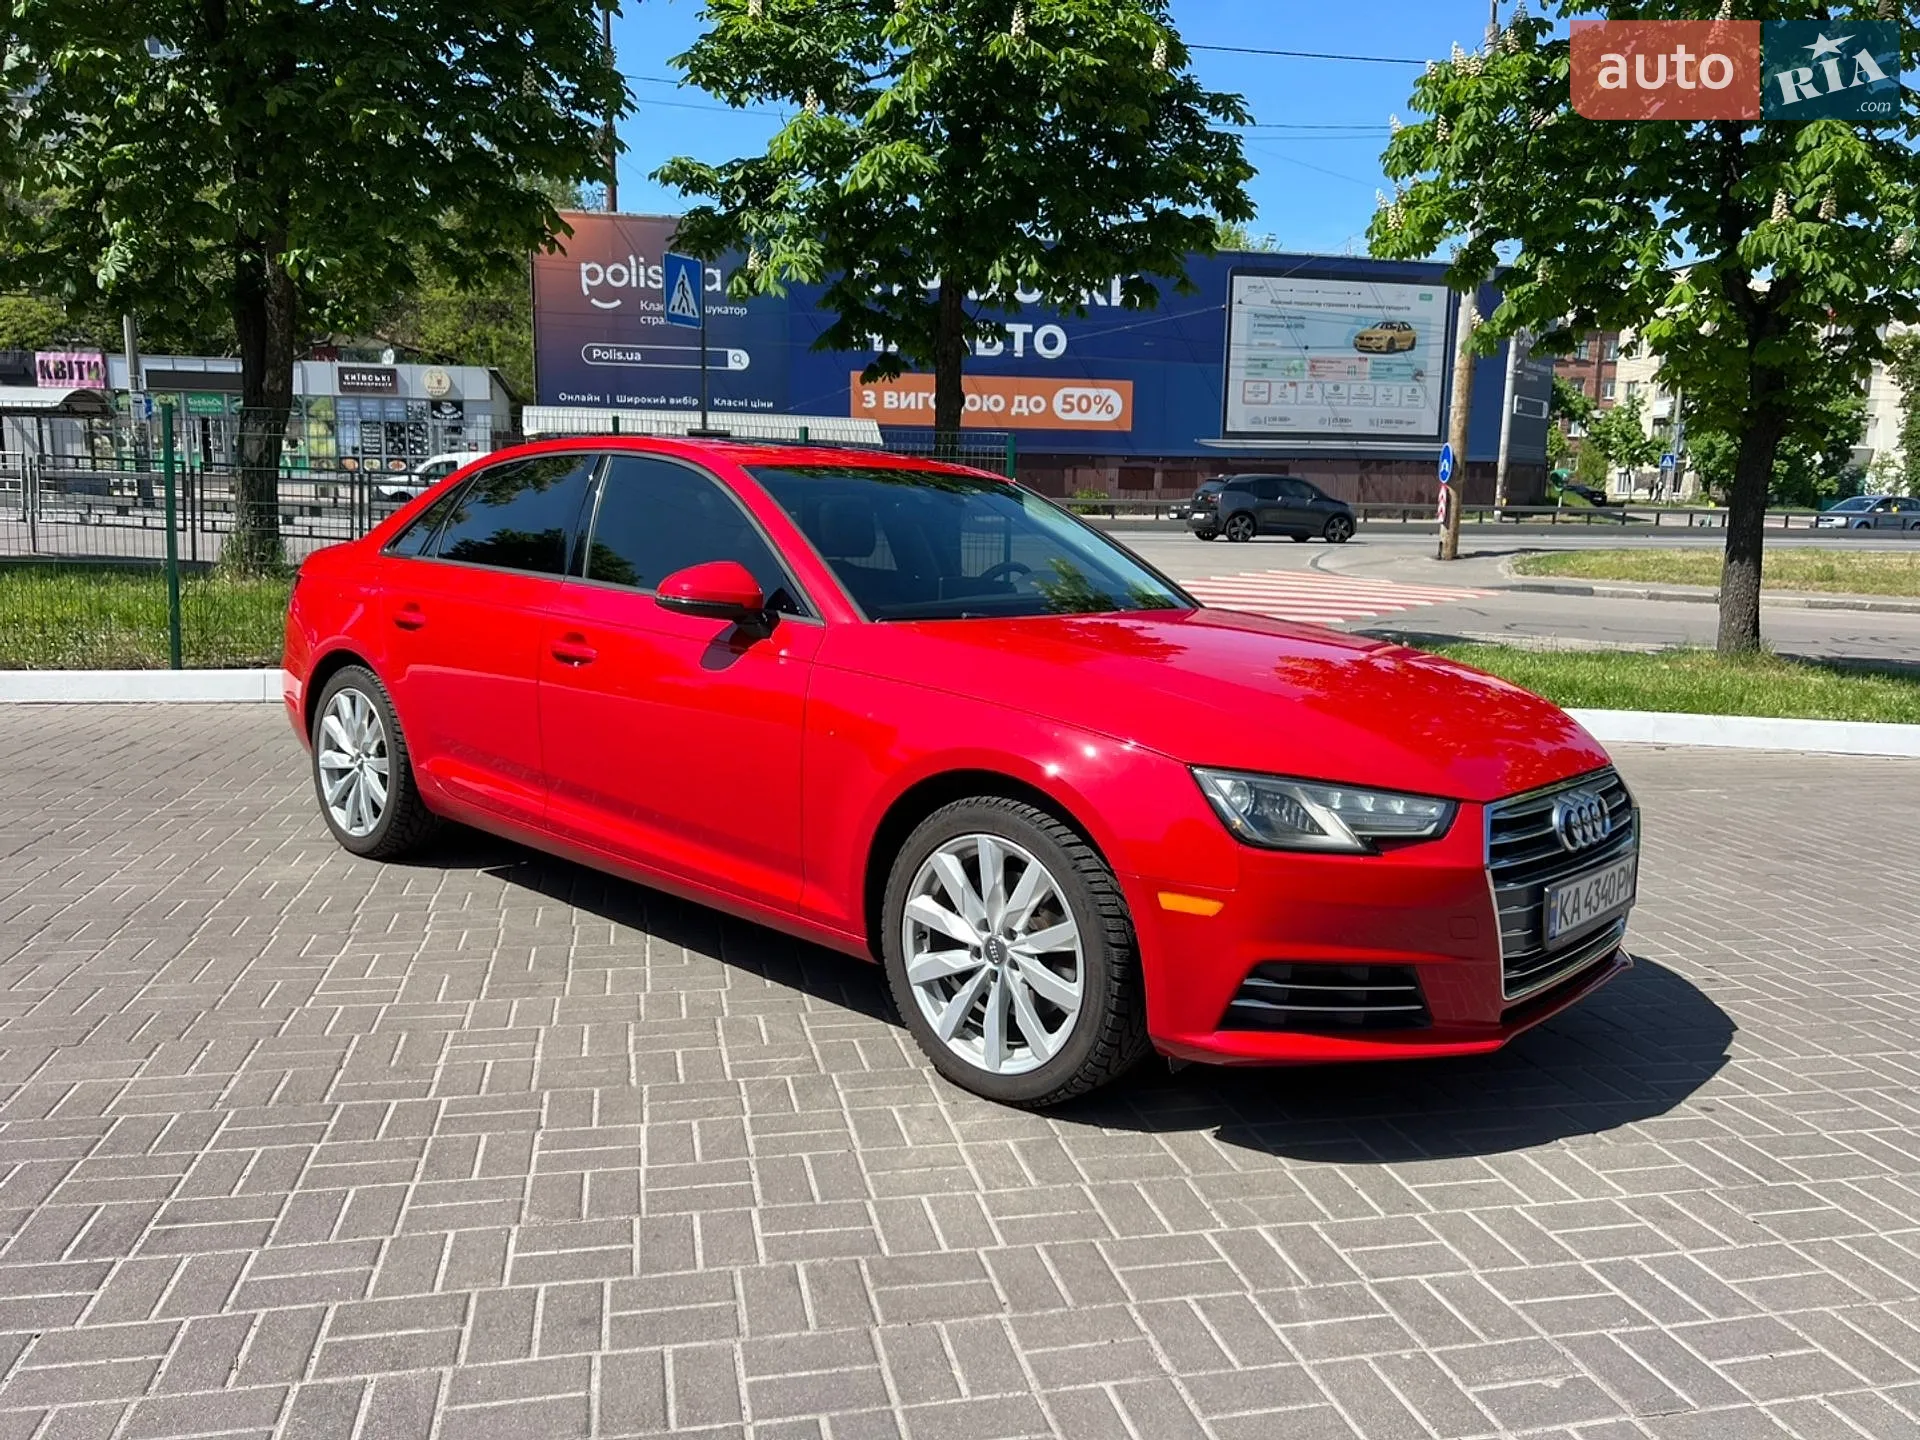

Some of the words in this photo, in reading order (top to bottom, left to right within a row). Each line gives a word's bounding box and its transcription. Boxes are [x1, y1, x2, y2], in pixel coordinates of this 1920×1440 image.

[580, 254, 722, 296] polisa
[592, 348, 642, 361] Polis.ua
[39, 359, 100, 380] КВІТИ
[343, 373, 391, 382] КИЇВСЬКІ
[558, 392, 600, 403] Онлайн
[616, 395, 666, 406] Широкий
[669, 395, 699, 406] вибір
[713, 397, 748, 407] Класні
[750, 398, 774, 409] ціни
[862, 390, 877, 409] З
[883, 391, 1005, 414] ВИГОЮ
[1061, 393, 1115, 415] 50%
[1558, 887, 1581, 929] KA
[1584, 872, 1616, 916] 4340
